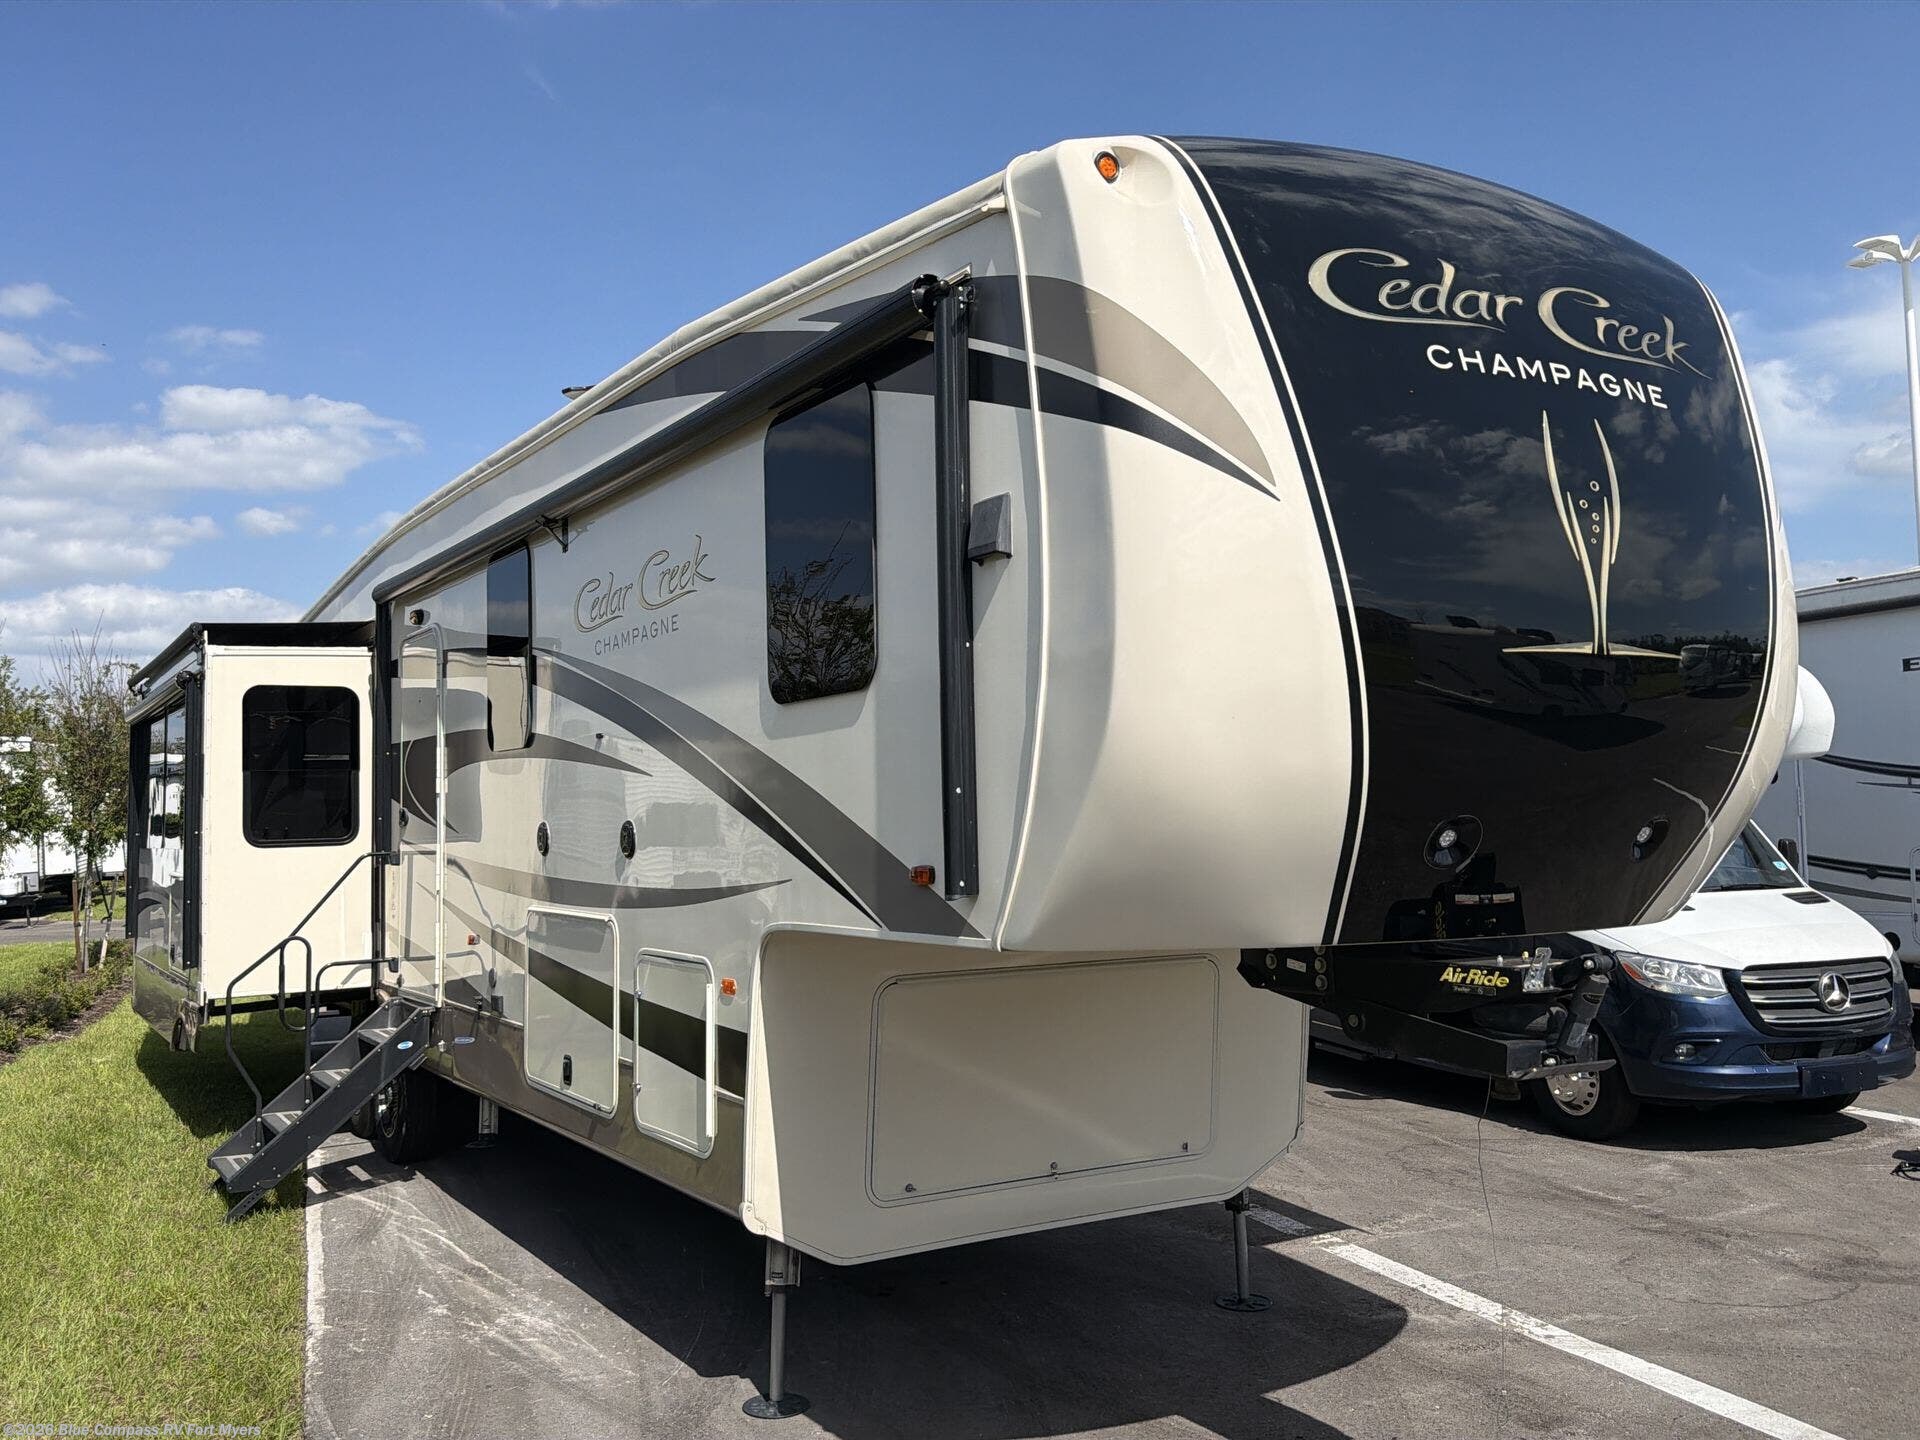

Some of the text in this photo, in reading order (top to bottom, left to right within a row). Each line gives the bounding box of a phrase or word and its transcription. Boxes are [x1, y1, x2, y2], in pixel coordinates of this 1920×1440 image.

[1308, 248, 1712, 380] Cedar Creek
[1426, 344, 1669, 409] CHAMPAGNE
[575, 535, 716, 633] Cedar Creek
[594, 614, 679, 656] CHAMPAGNE
